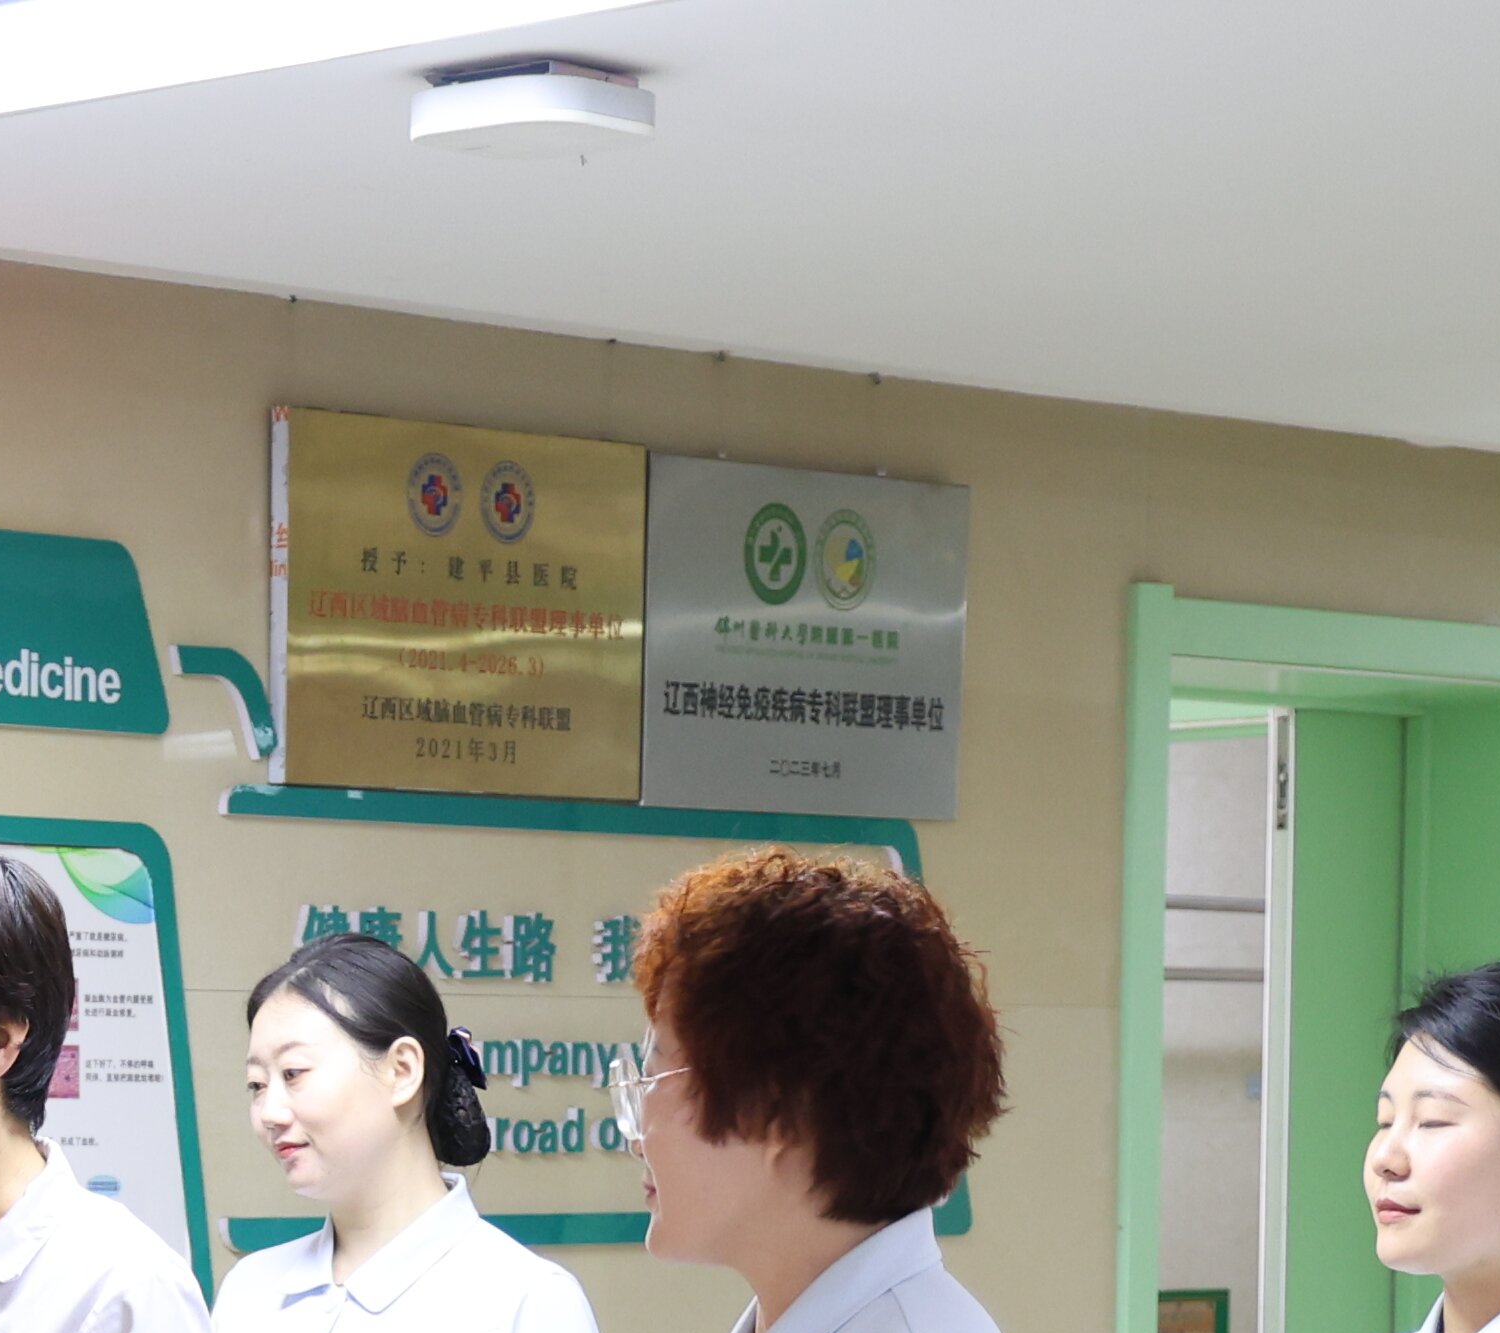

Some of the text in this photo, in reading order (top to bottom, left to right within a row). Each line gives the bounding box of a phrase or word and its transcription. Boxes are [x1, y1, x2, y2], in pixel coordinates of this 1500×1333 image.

[361, 695, 572, 732] 辽西区域脑血管病专科联盟
[663, 680, 945, 731] 辽西神经免疫疾病专科联盟理事单位
[415, 737, 517, 764] 2021年3月
